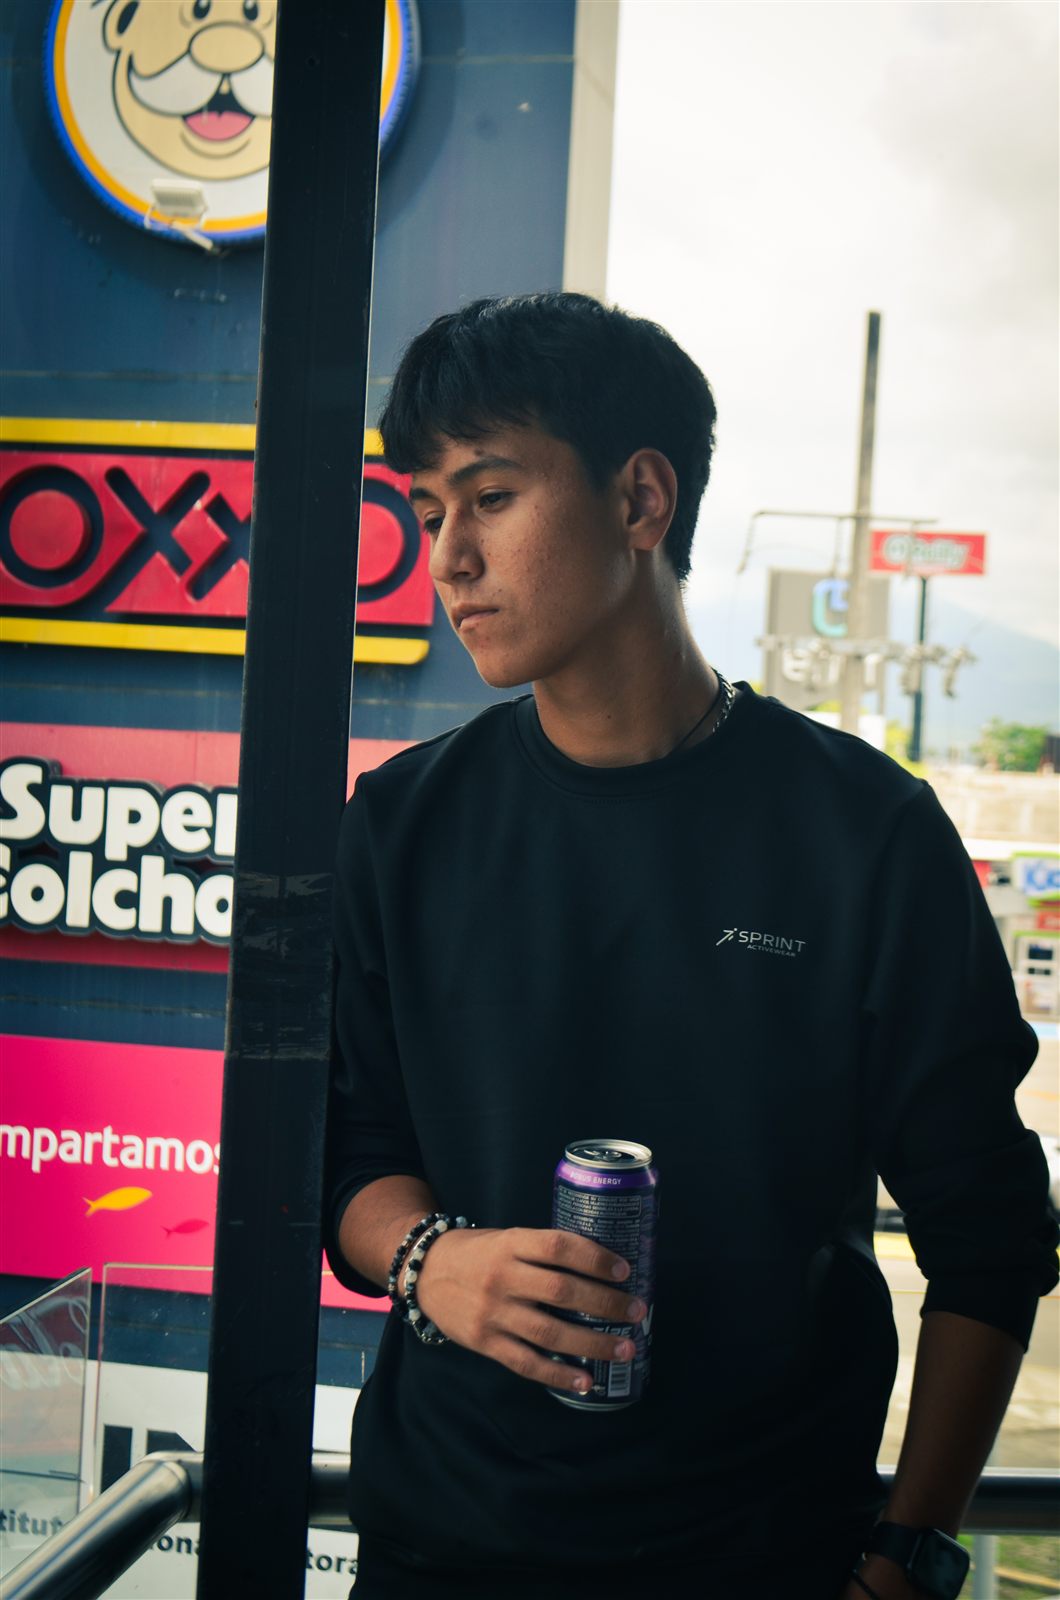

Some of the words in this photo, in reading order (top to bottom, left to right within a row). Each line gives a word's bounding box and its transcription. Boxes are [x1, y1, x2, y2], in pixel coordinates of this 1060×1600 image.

[738, 931, 806, 952] SPRINT
[747, 944, 796, 957] ACTIVEWEAR
[593, 1176, 621, 1185] ENERGY
